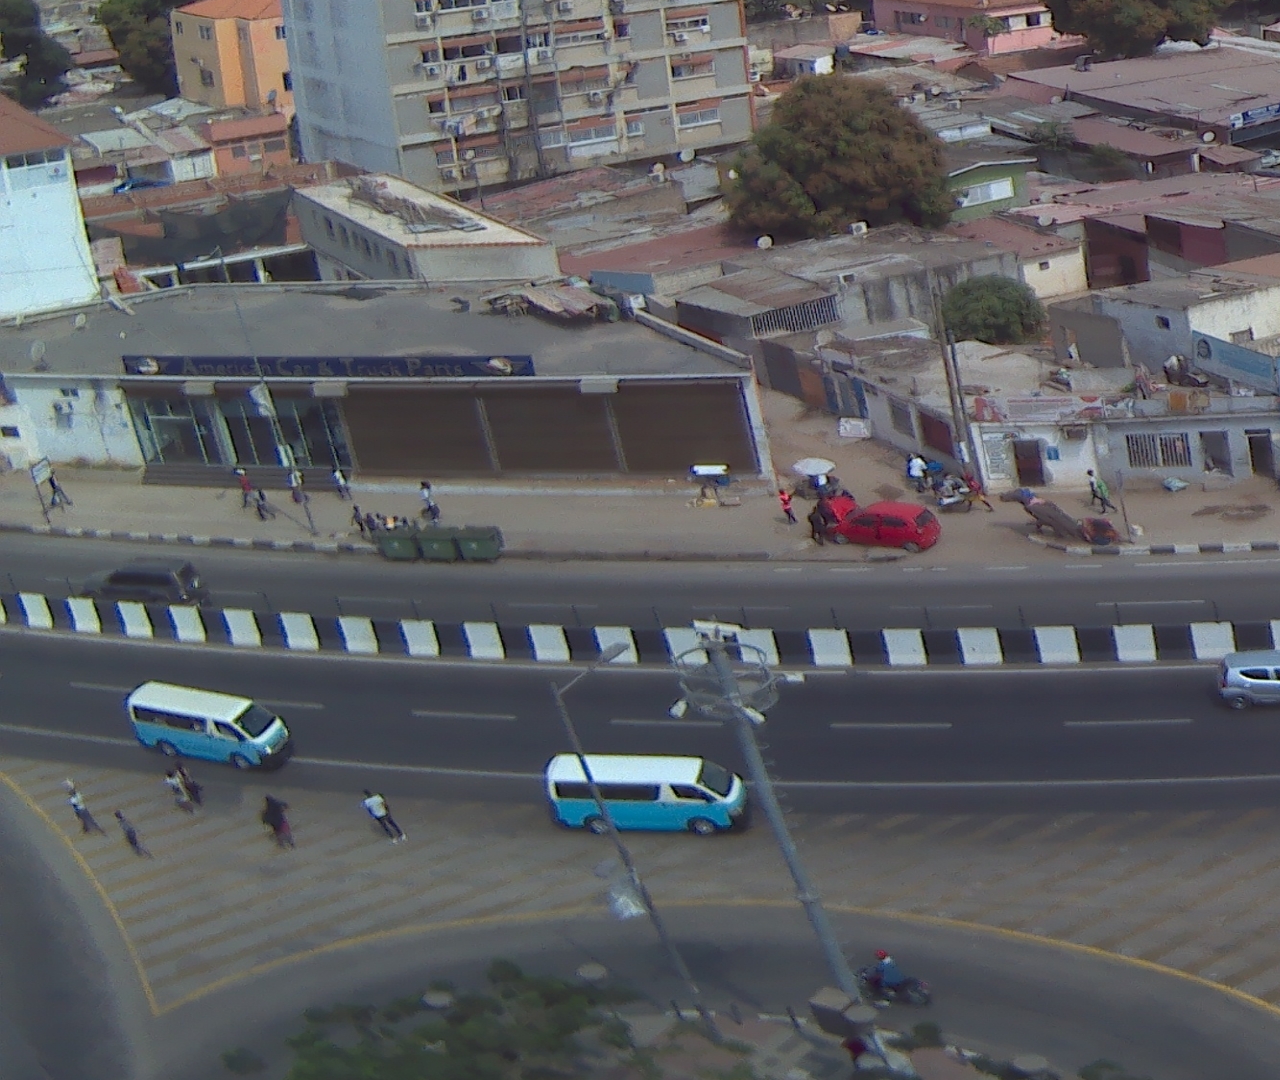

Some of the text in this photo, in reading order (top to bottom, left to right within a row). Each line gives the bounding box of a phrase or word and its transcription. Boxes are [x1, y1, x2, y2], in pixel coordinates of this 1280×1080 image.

[182, 357, 272, 375] American
[276, 357, 311, 375] Car
[339, 357, 402, 376] Truck
[406, 358, 464, 376] Parts
